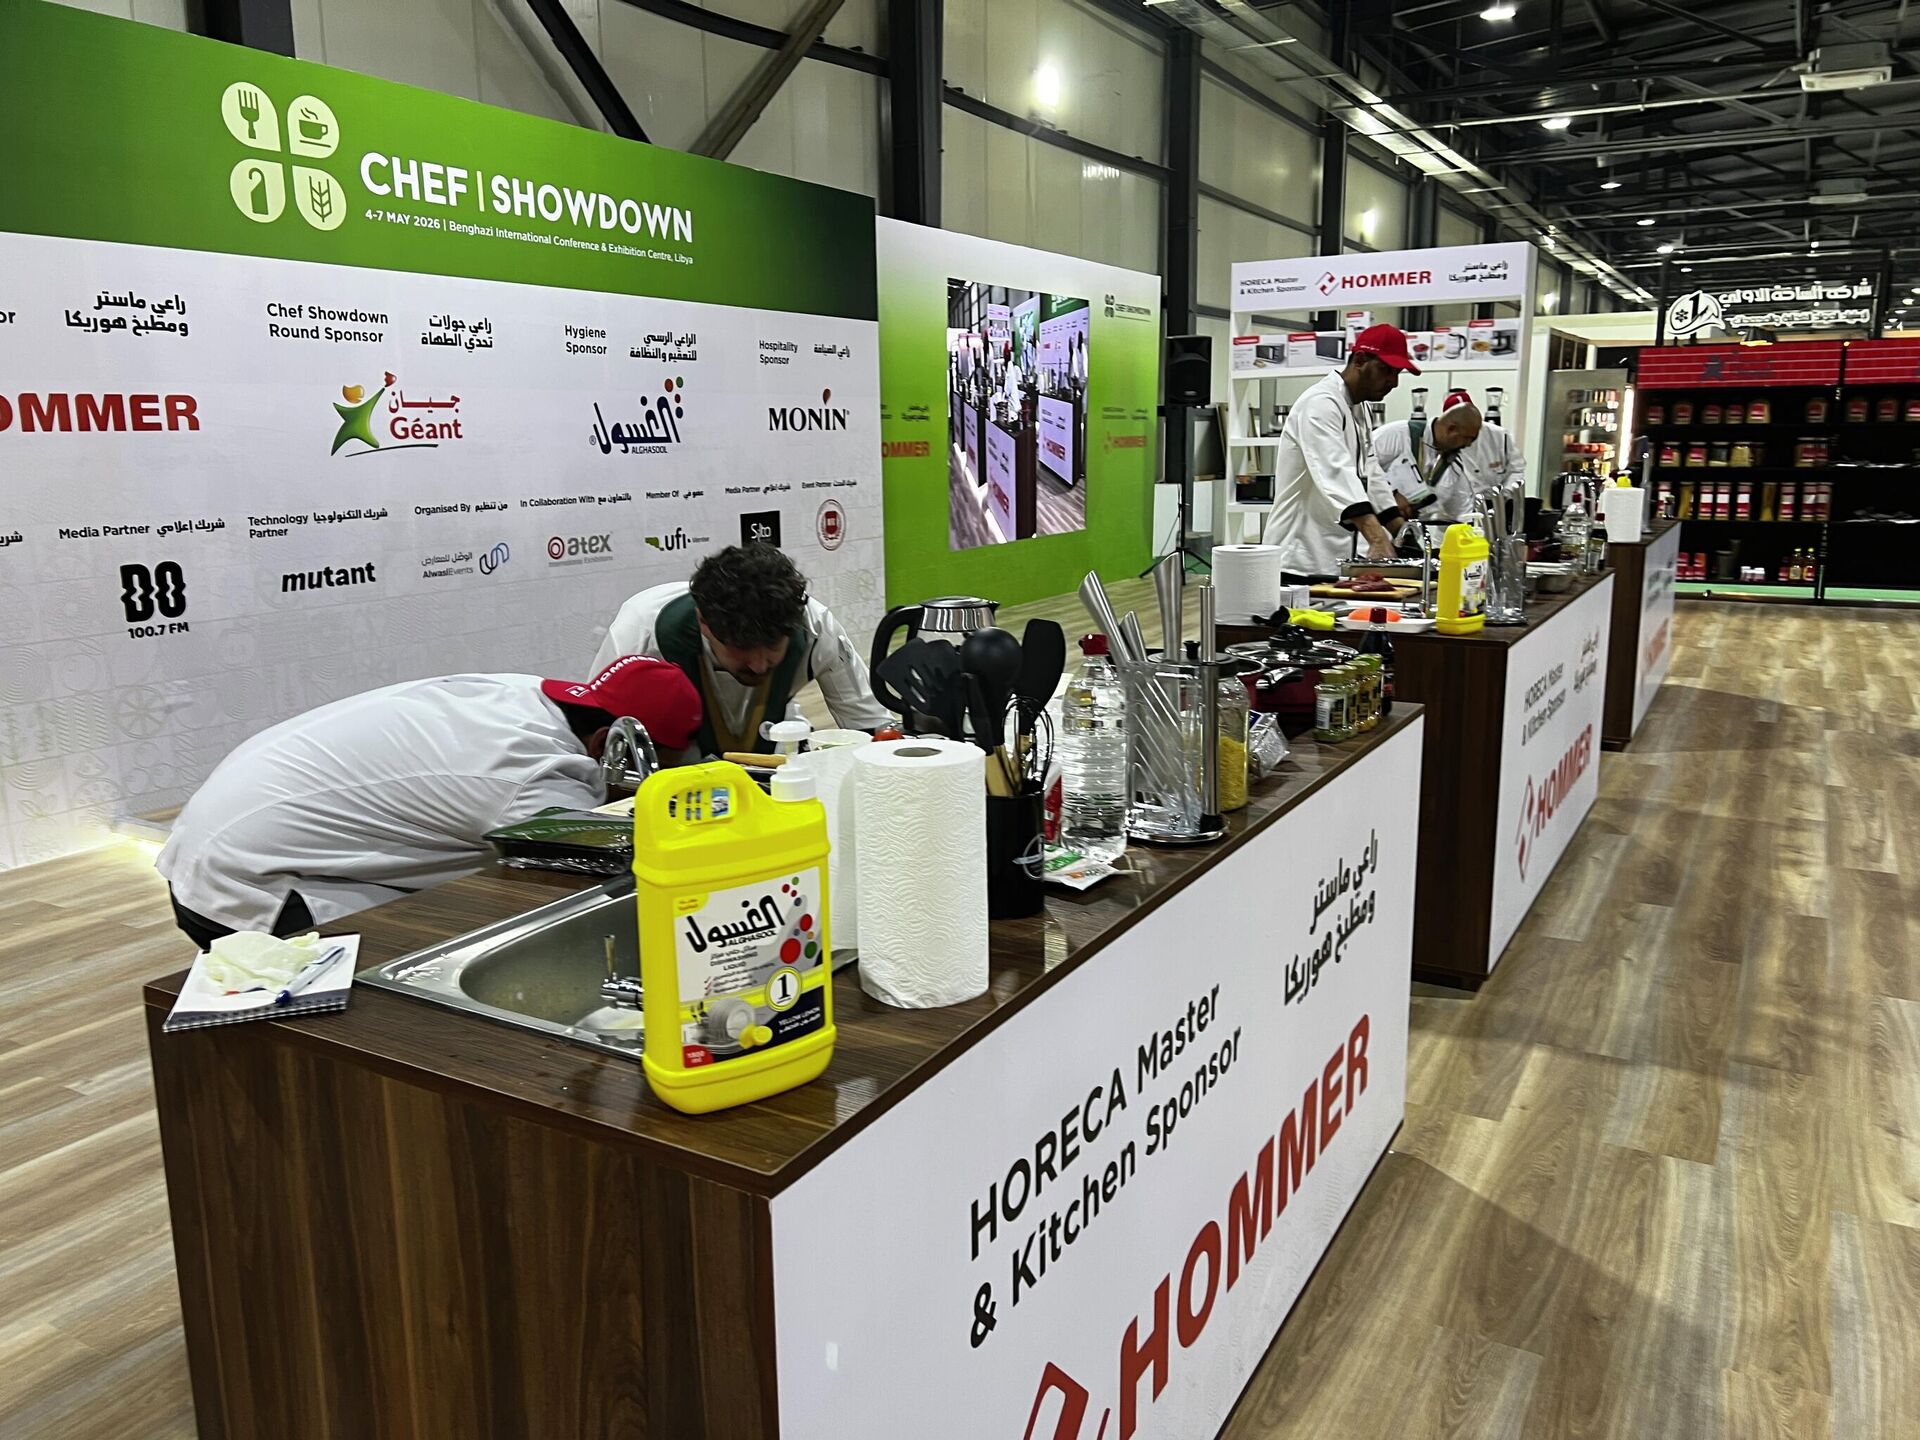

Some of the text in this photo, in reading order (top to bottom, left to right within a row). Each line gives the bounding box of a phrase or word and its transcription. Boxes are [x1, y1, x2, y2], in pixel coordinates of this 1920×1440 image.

[360, 152, 693, 243] CHEF SHOWDOWN
[365, 209, 383, 222] 4-7
[386, 211, 410, 225] MAY
[413, 215, 440, 229] 2026
[449, 220, 493, 236] Benghazi
[496, 227, 551, 245] International
[553, 235, 600, 251] Conference
[601, 242, 607, 252] &
[608, 243, 646, 257] Exhibition
[674, 253, 694, 265] Libya
[1341, 271, 1432, 289] HOMMER
[93, 290, 187, 318] راعي ماستر
[267, 303, 389, 324] Chef Showdown
[64, 309, 189, 337] ومطبخ هوريكا
[429, 314, 492, 337] راعي جولات
[564, 324, 607, 340] Hygiene
[269, 324, 384, 343] Round Sponsor
[421, 331, 493, 353] تحدي الطهاة
[643, 331, 673, 347] الرسمي
[565, 341, 608, 355] Sponsor
[629, 346, 667, 363] والنظافة
[759, 339, 798, 354] Hospitality
[760, 353, 790, 366] Sponsor
[389, 417, 463, 440] Géant
[768, 407, 848, 432] MONIN
[631, 445, 668, 455] ALGHASOOL
[414, 503, 471, 516] Organised By
[475, 501, 496, 513] تنظيم
[520, 495, 595, 507] In Collaboration With
[248, 514, 308, 526] Technology
[313, 508, 388, 524] شريك التكنولوجيا
[59, 525, 150, 540] Media Partner
[156, 518, 225, 537] شريك إعلامي
[249, 528, 288, 539] Partner
[567, 534, 613, 556] atex
[665, 527, 687, 551] ufi
[281, 562, 376, 593] mutant
[128, 621, 189, 639] 100.7 FM
[1536, 723, 1592, 838] HOMMER
[1309, 857, 1351, 935] ماستر
[728, 930, 776, 946] ALGHASOOL
[1284, 889, 1376, 1006] ومطبخ هوريكا
[778, 974, 791, 999] 1
[779, 1014, 801, 1026] YELLOW
[971, 984, 1220, 1261] HORECA Master
[970, 1026, 1242, 1348] & Kitchen Sponsor
[1119, 1014, 1370, 1440] HOMMER
